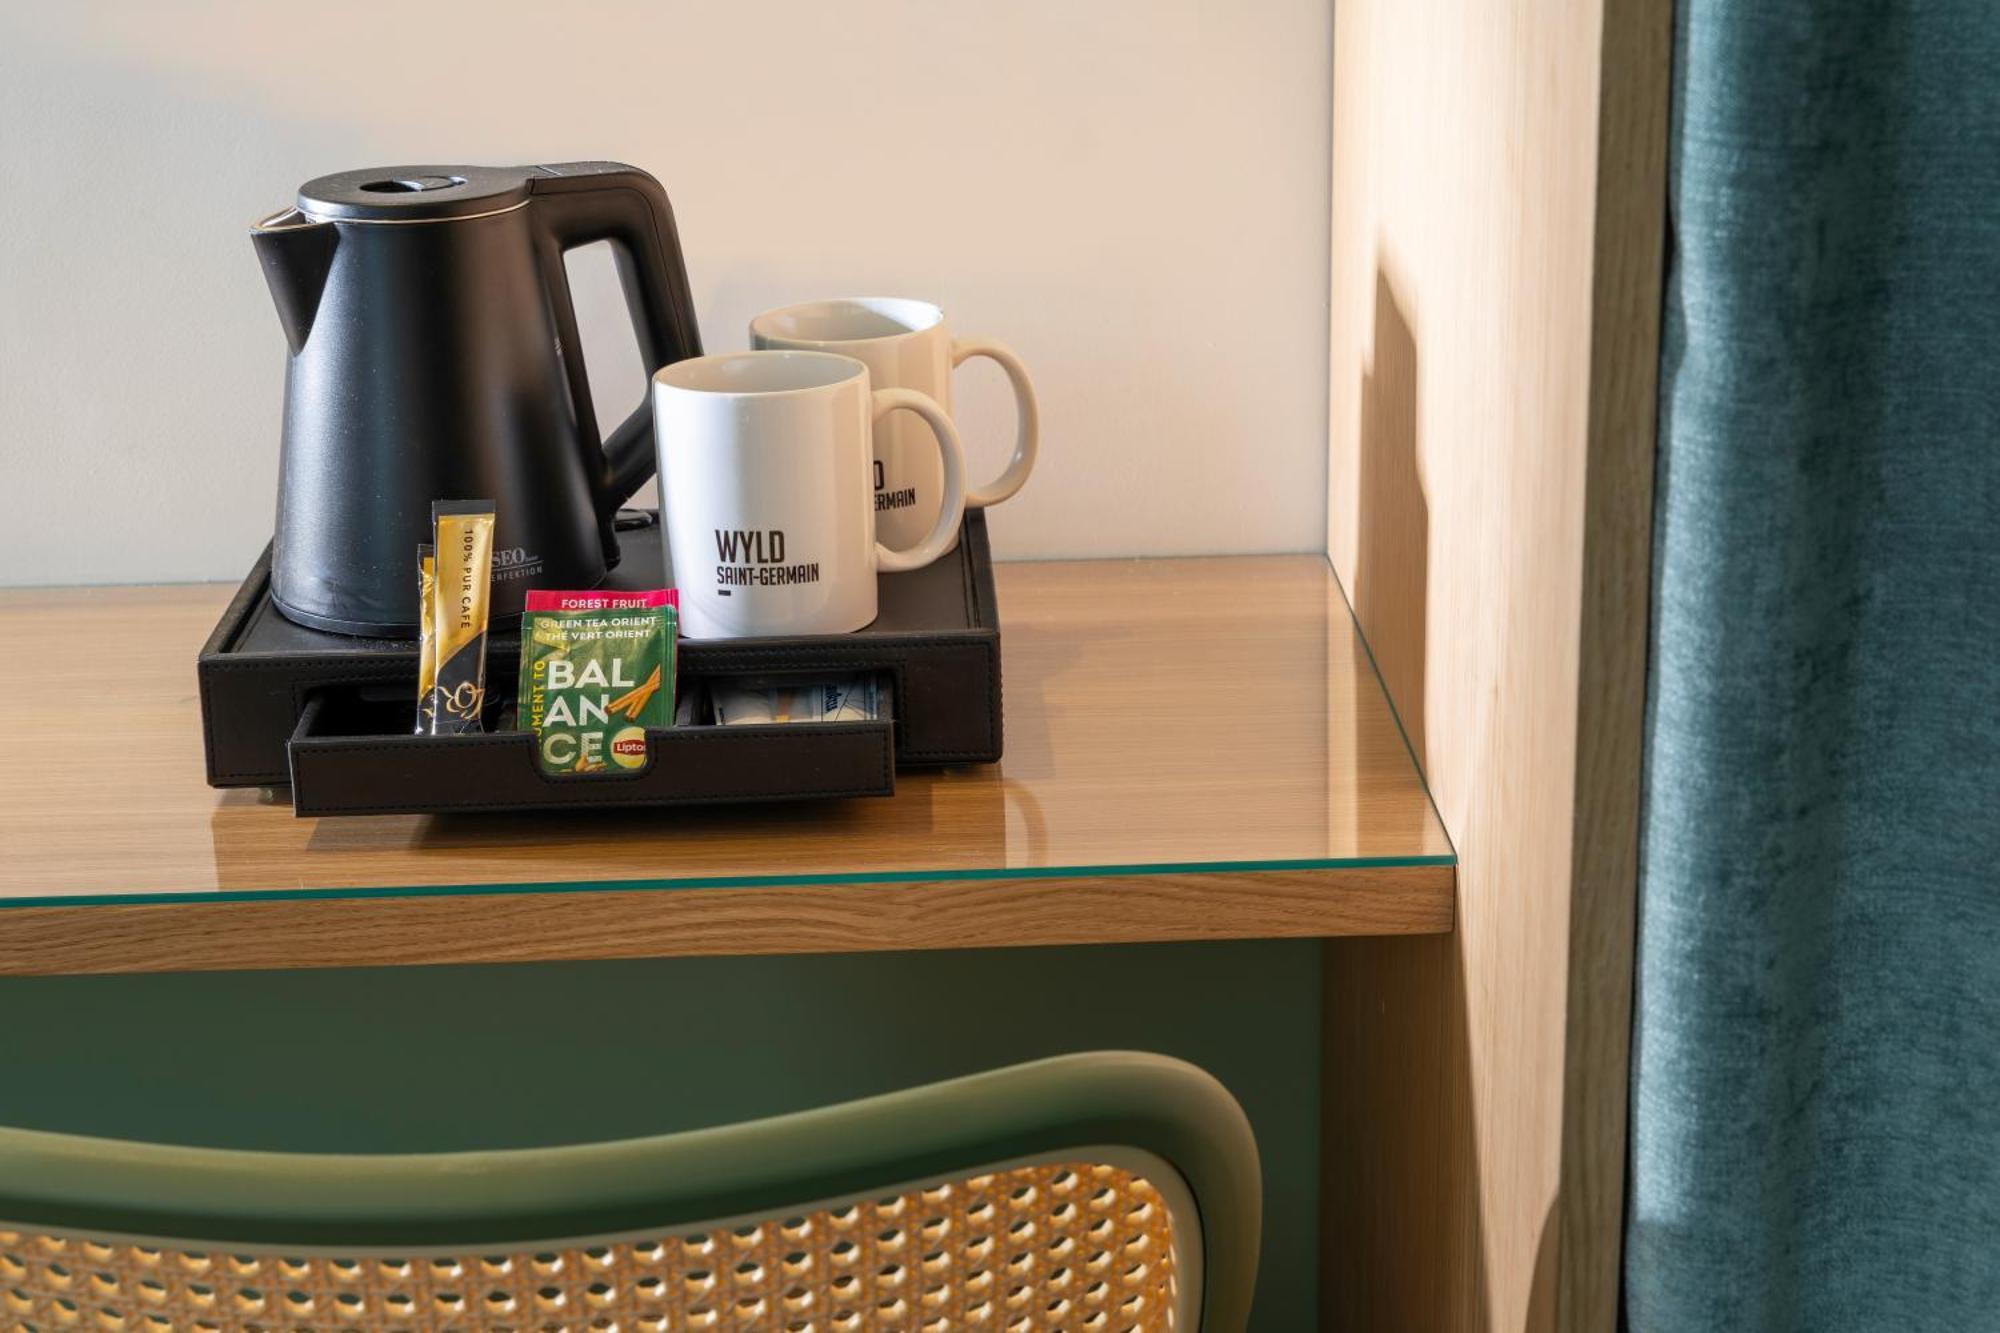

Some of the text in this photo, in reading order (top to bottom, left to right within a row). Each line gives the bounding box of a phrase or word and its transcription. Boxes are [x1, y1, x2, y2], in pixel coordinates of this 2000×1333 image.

[463, 529, 473, 562] 100%
[715, 529, 785, 564] WYLD
[462, 567, 472, 592] PUR
[716, 563, 820, 586] SAINT-GERMAIN
[561, 599, 648, 609] FOREST FRUIT
[540, 616, 657, 629] GREEN TEA ORIENT
[571, 631, 601, 640] VERT
[604, 629, 651, 639] ORIENT
[533, 660, 545, 679] TO
[548, 659, 634, 689] BAL
[543, 693, 609, 728] AN
[543, 731, 603, 765] CE
[616, 743, 646, 754] Lipto
